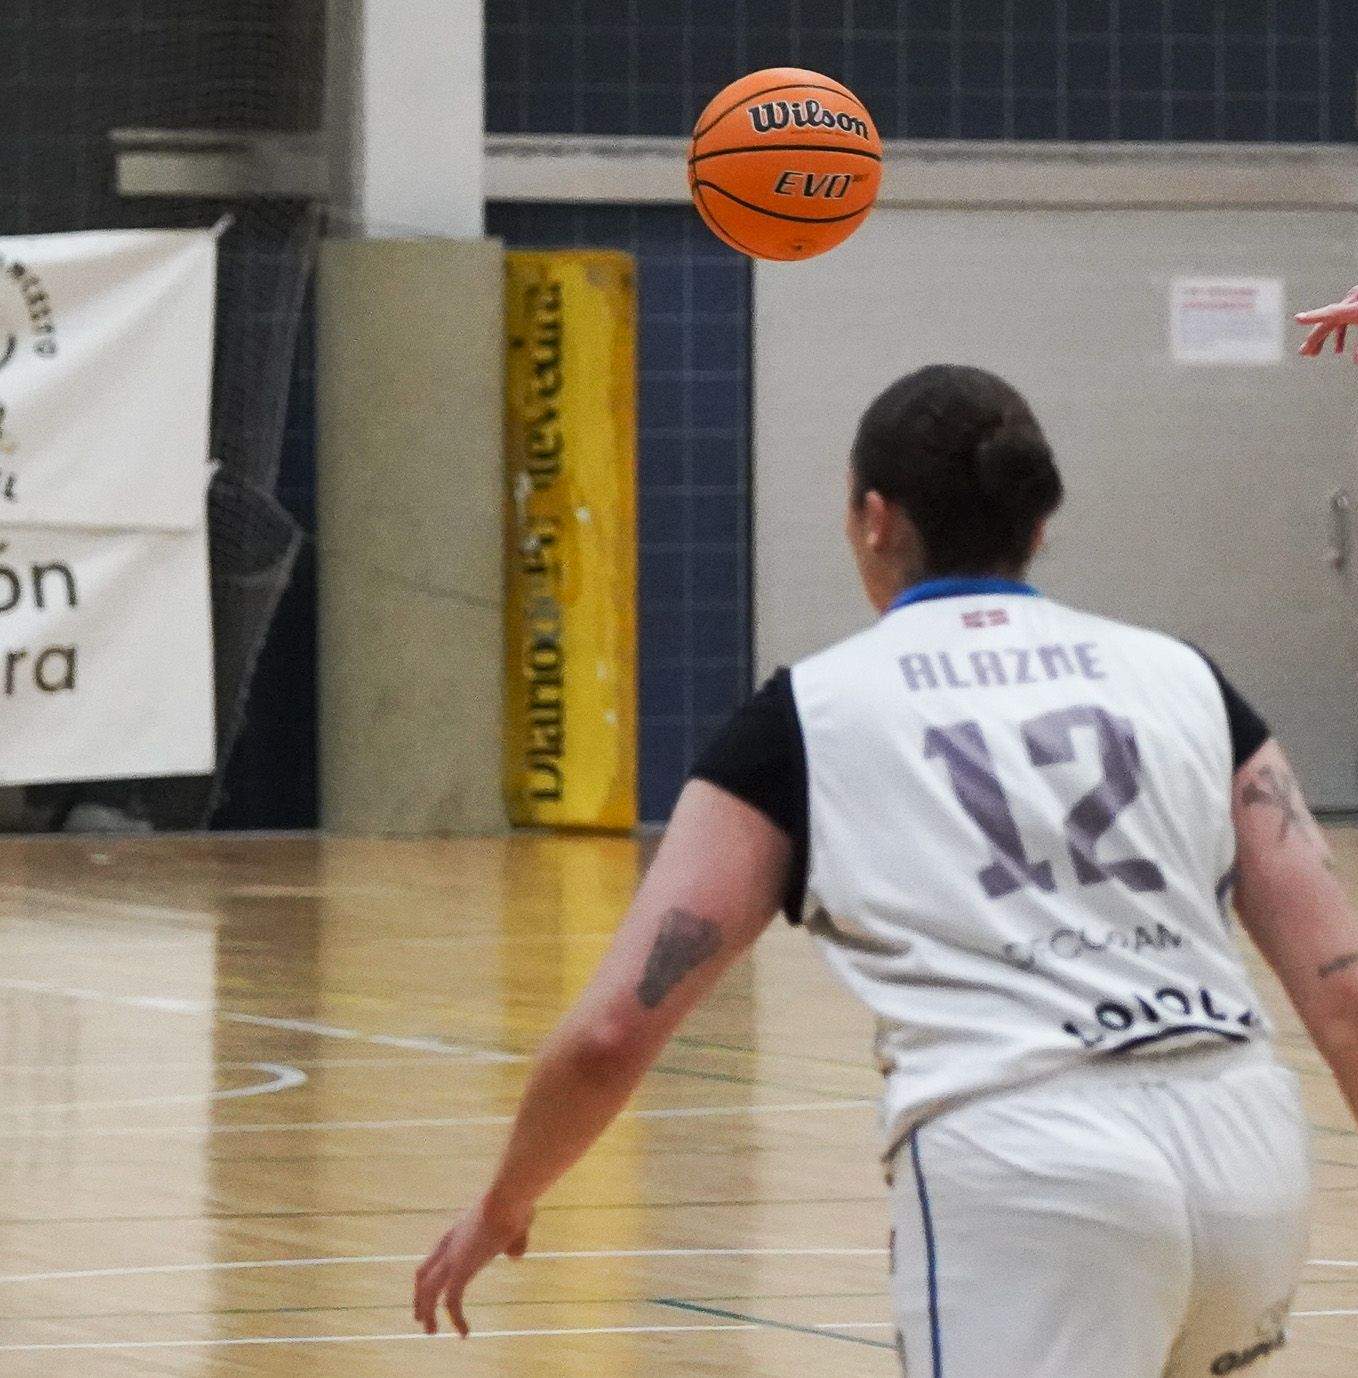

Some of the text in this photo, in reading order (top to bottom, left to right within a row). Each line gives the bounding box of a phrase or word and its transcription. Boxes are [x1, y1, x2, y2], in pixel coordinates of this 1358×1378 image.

[747, 98, 868, 141] Wilson
[774, 170, 852, 198] EVO
[4, 646, 77, 696] ra
[898, 642, 1107, 691] ALAZNE
[922, 704, 1166, 900] 12
